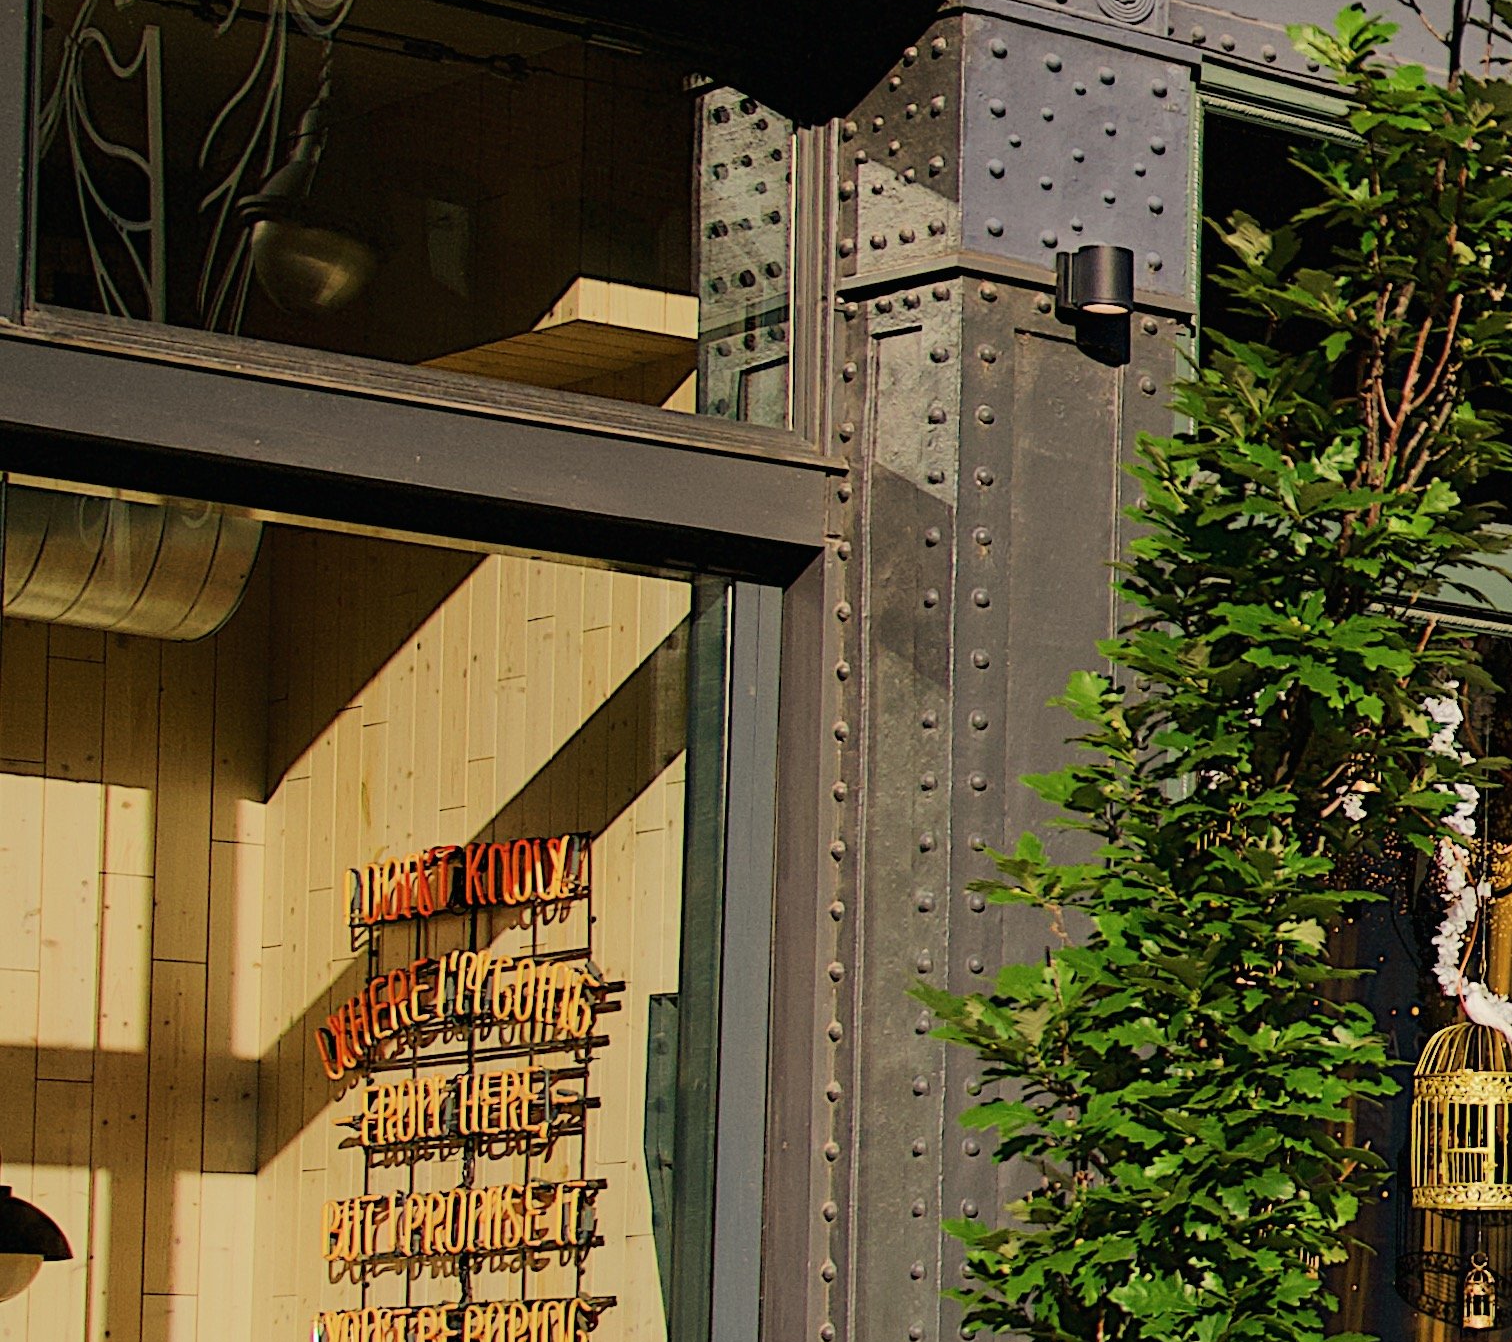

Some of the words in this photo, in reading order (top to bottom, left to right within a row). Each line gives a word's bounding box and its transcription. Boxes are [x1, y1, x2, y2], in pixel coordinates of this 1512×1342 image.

[465, 834, 571, 906] KNOW
[315, 957, 431, 1081] WHERE
[435, 949, 492, 1020] I'M
[491, 954, 600, 1038] GOING
[360, 1073, 447, 1146] FROM
[321, 1194, 383, 1262] BUT
[402, 1181, 544, 1257] PROMISE
[555, 1180, 589, 1247] IT
